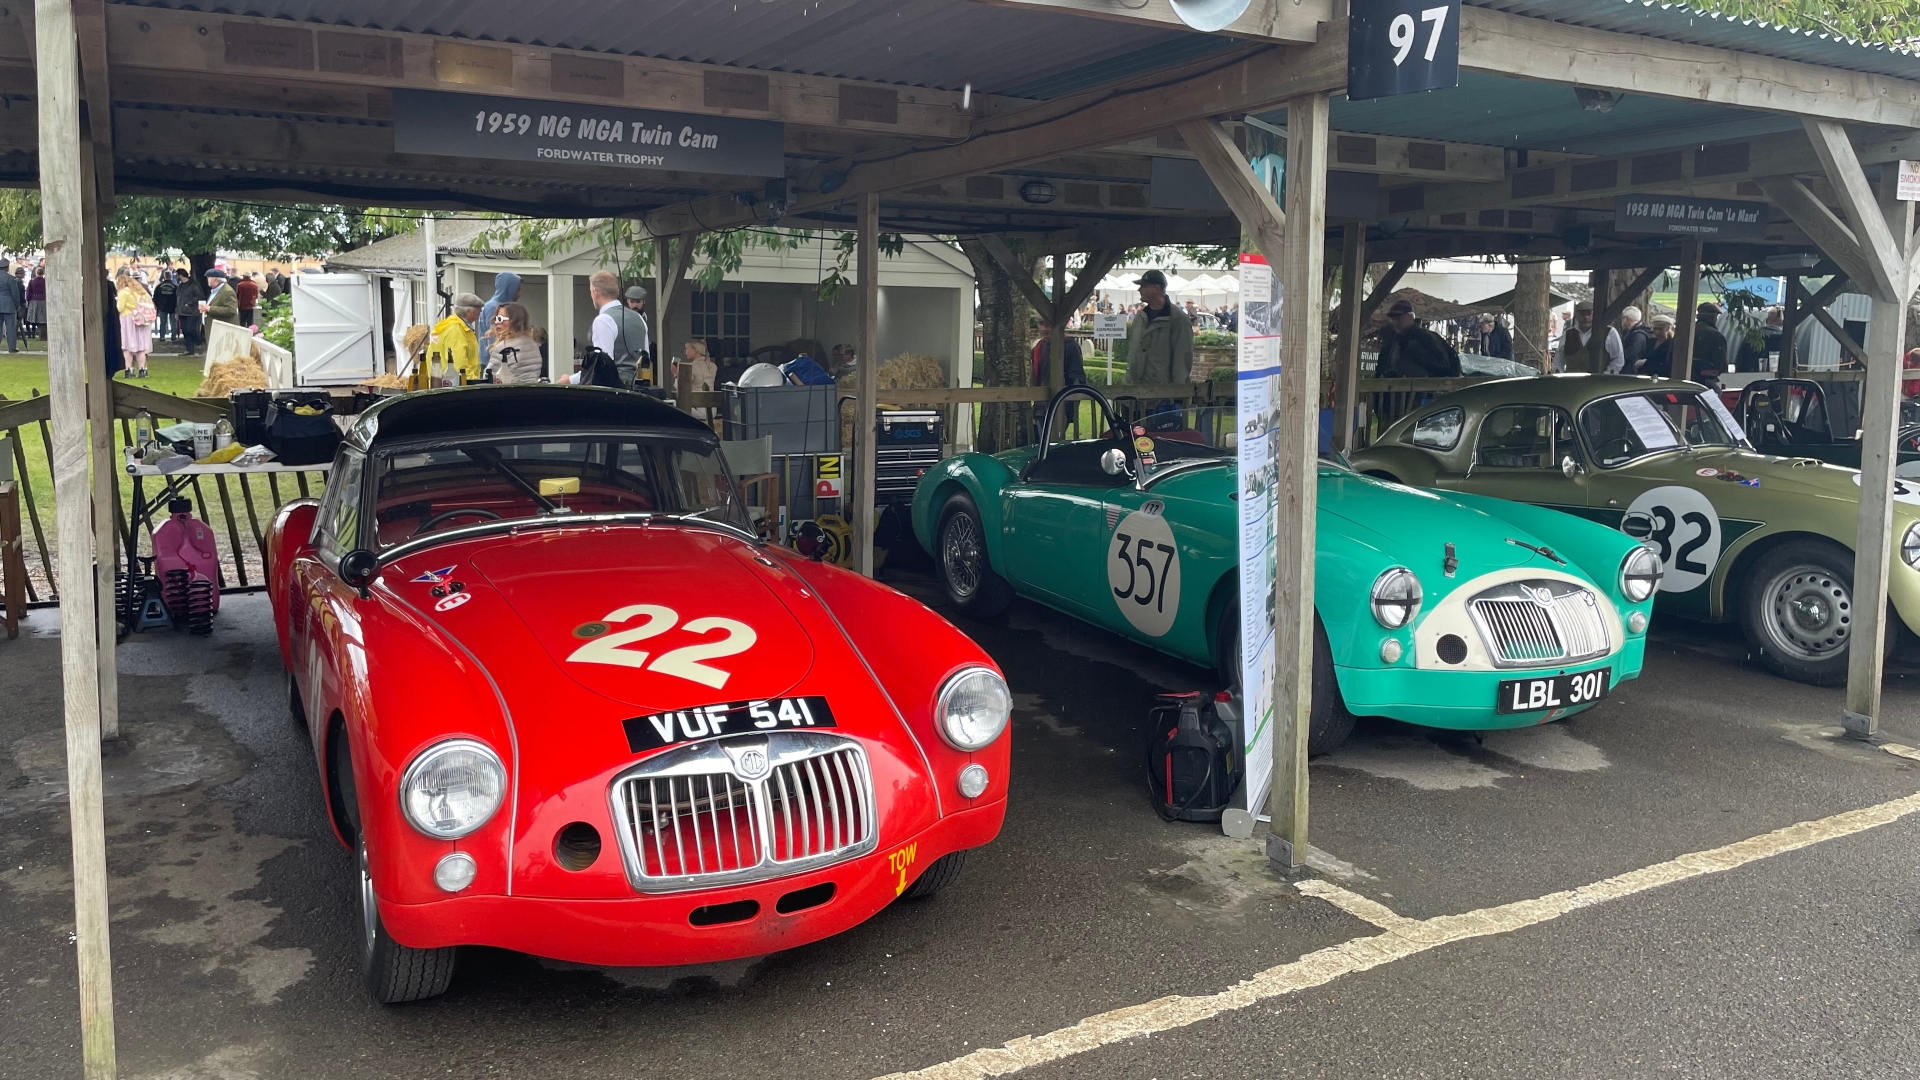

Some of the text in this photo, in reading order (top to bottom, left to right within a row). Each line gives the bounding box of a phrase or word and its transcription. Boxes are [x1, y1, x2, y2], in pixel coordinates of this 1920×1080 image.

[1388, 5, 1449, 67] 97
[475, 110, 719, 149] 1959 MG MGA Twin Cam
[537, 148, 665, 166] FORDWATER TROPHY
[1626, 202, 1650, 217] 1958
[1650, 203, 1665, 218] MG
[1665, 204, 1685, 219] MGA
[1687, 205, 1705, 220] Twin
[1706, 206, 1724, 221] Cam
[1737, 208, 1760, 223] Mans'
[1699, 226, 1719, 234] TROPHY
[904, 429, 922, 438] SGS
[1143, 503, 1160, 516] 132
[1113, 532, 1176, 614] 357
[565, 603, 758, 691] 22
[1512, 671, 1604, 711] LBL 301
[647, 697, 815, 743] VUF 541
[743, 752, 764, 771] MG
[888, 841, 918, 875] TOW
